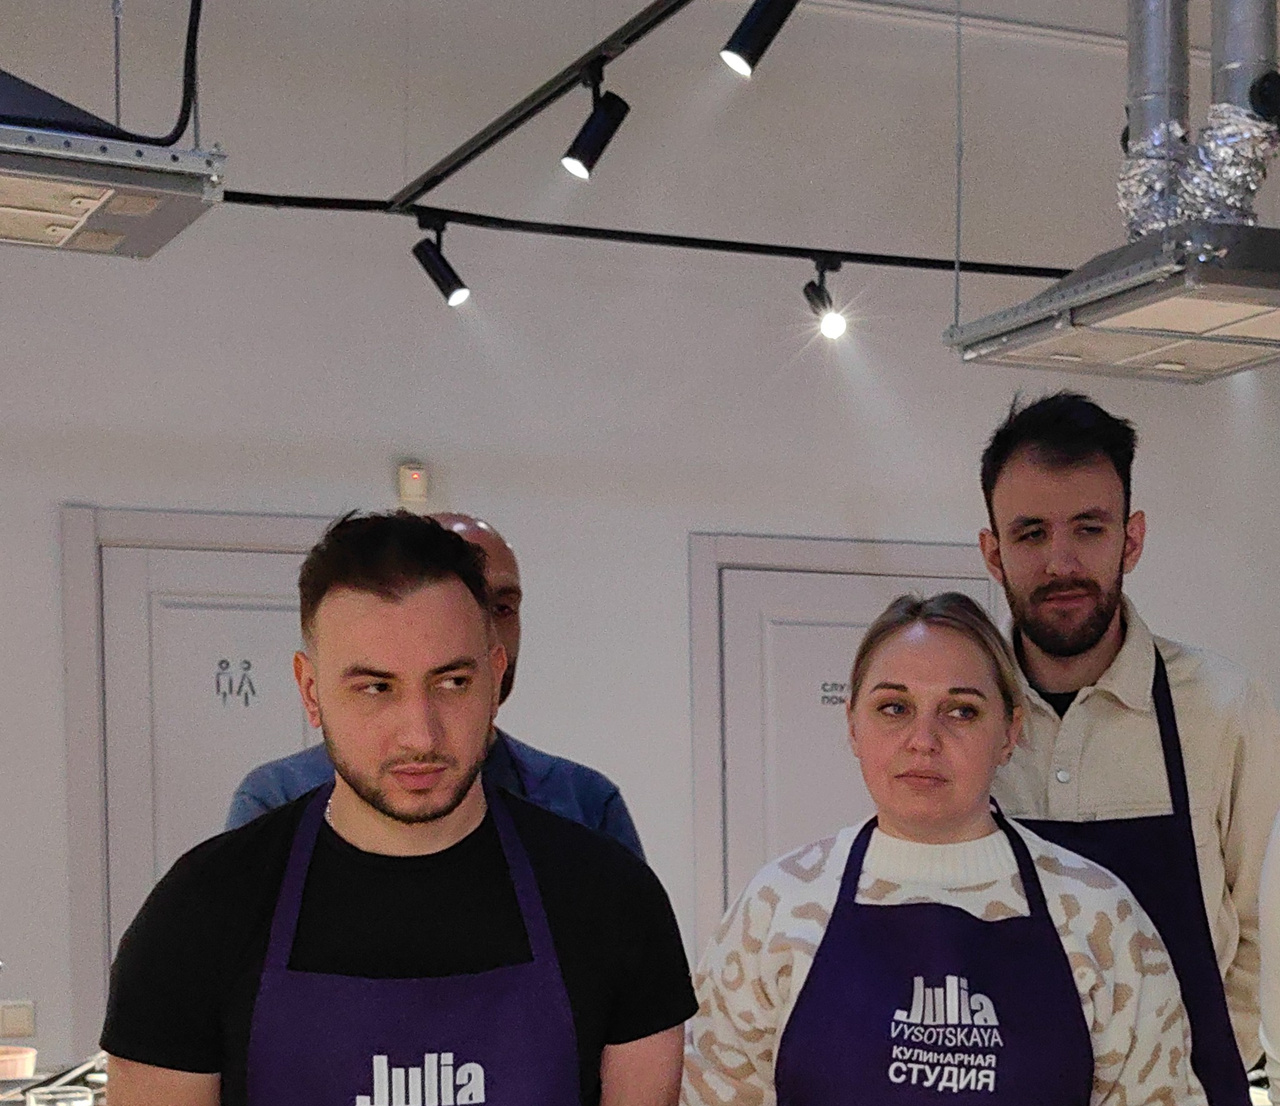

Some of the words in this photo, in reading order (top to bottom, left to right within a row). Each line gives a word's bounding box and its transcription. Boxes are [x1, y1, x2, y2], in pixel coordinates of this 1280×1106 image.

[893, 975, 1000, 1026] Julia
[890, 1021, 1004, 1048] VYSOTSKAYA
[892, 1045, 997, 1068] КУЛИНАРНАЯ
[888, 1061, 996, 1093] СТУДИЯ
